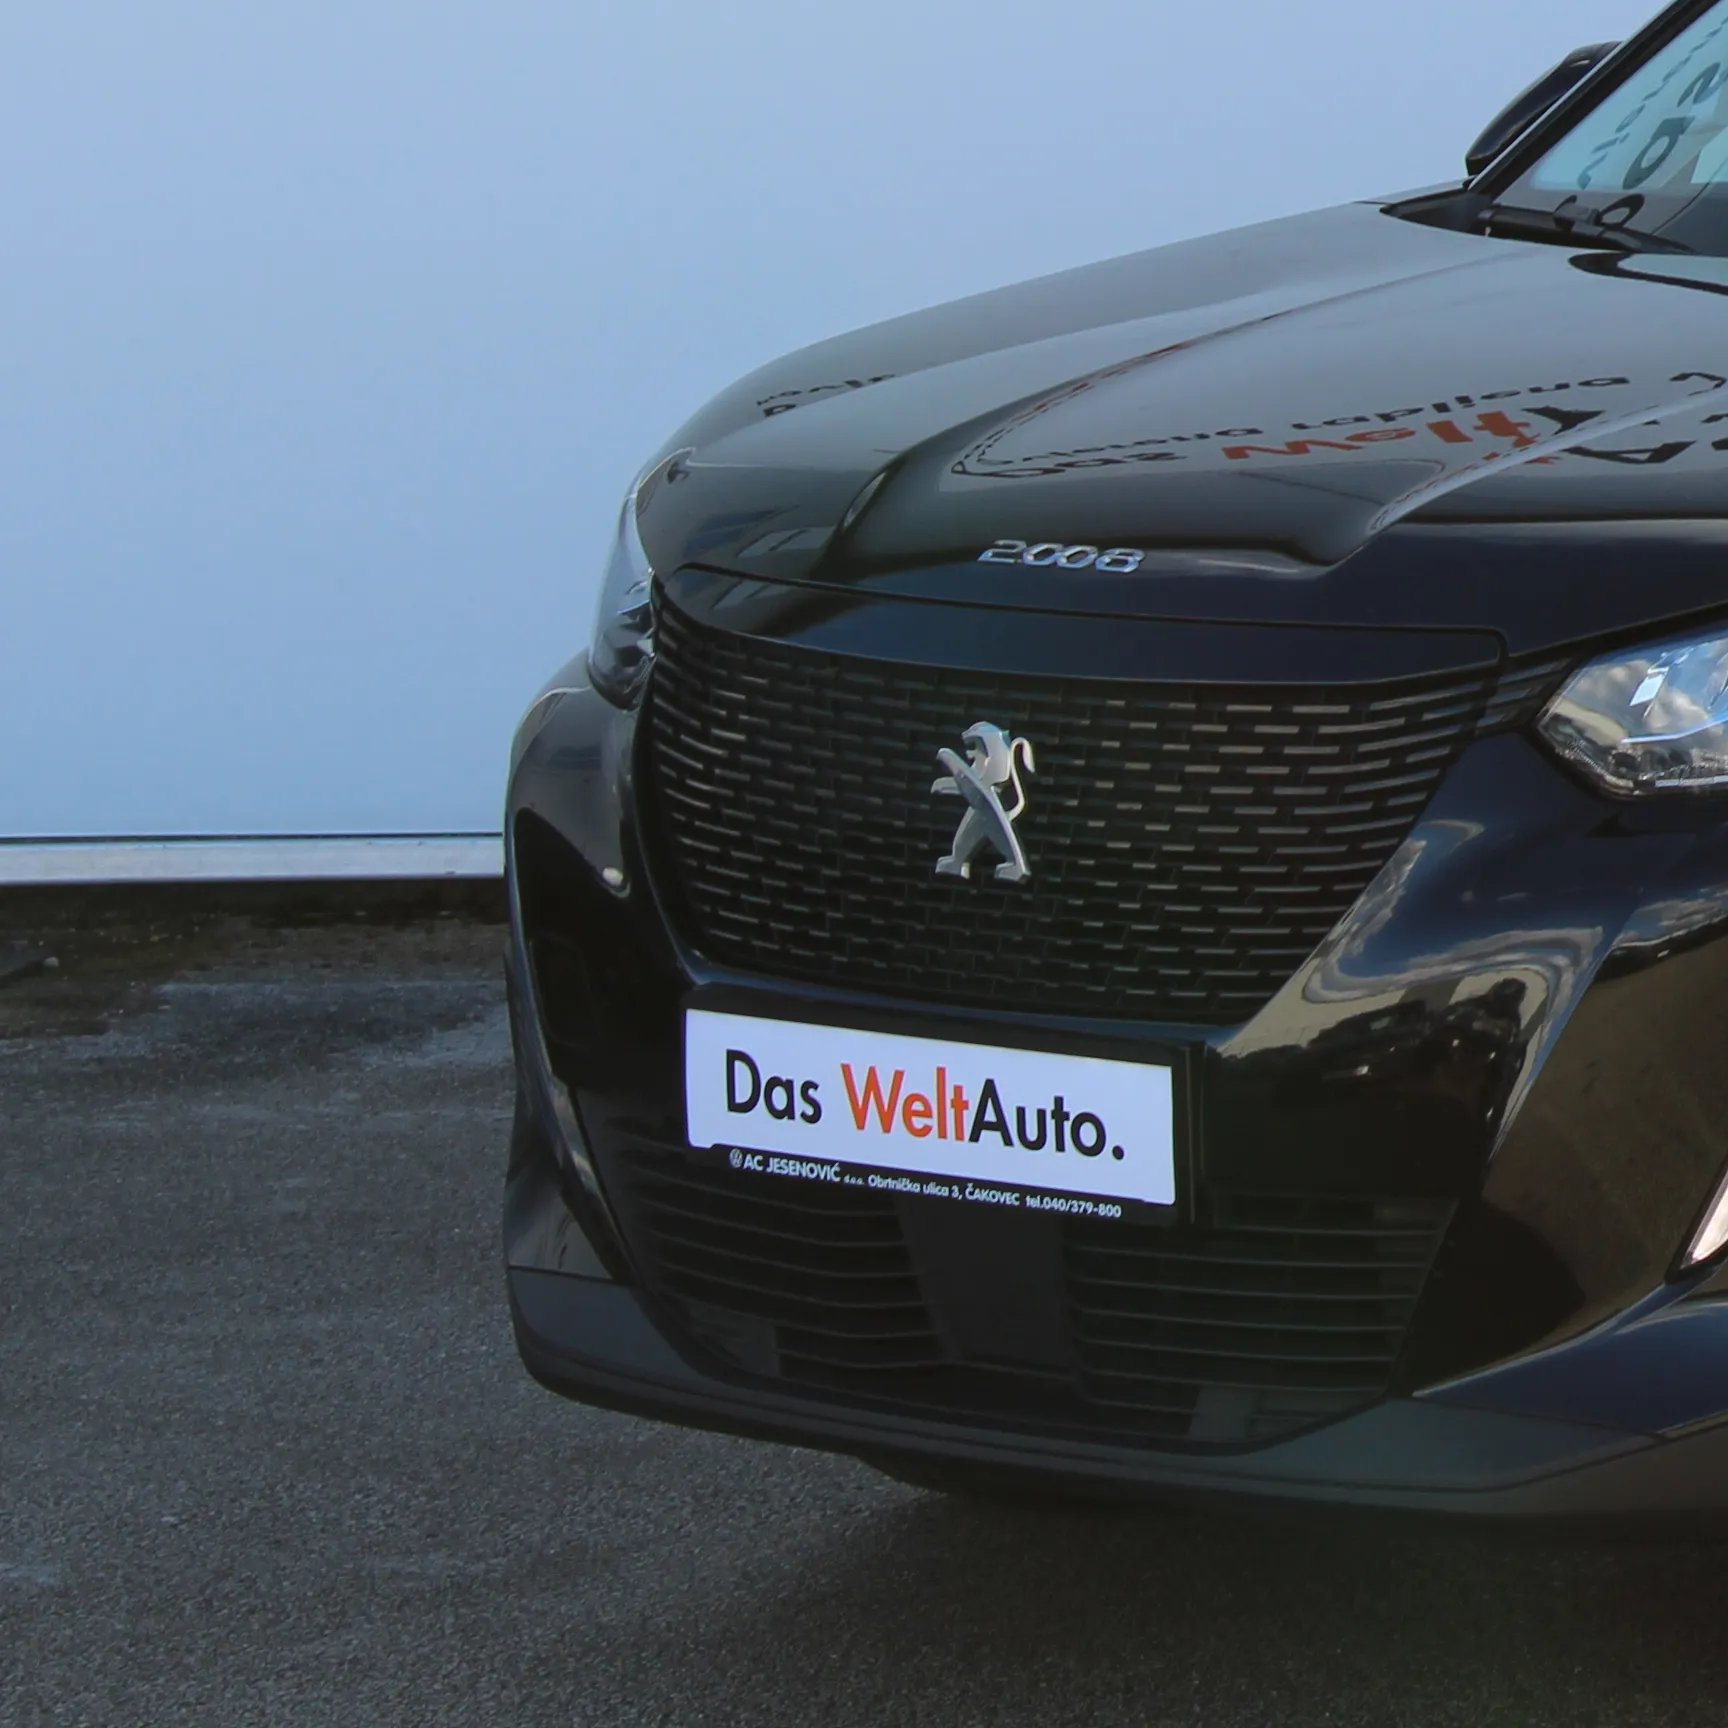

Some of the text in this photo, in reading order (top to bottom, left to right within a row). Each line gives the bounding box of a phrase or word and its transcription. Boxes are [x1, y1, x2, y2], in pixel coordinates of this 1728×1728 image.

[978, 539, 1147, 573] 2008
[725, 1049, 1126, 1161] Das WeltAuto.
[743, 1154, 764, 1171] AC
[766, 1157, 841, 1182] JESENOVIĆ
[868, 1174, 921, 1193] Obrtnička
[923, 1181, 949, 1197] ulica
[951, 1185, 962, 1201] 3,
[965, 1182, 1021, 1206] ČAKOVEC
